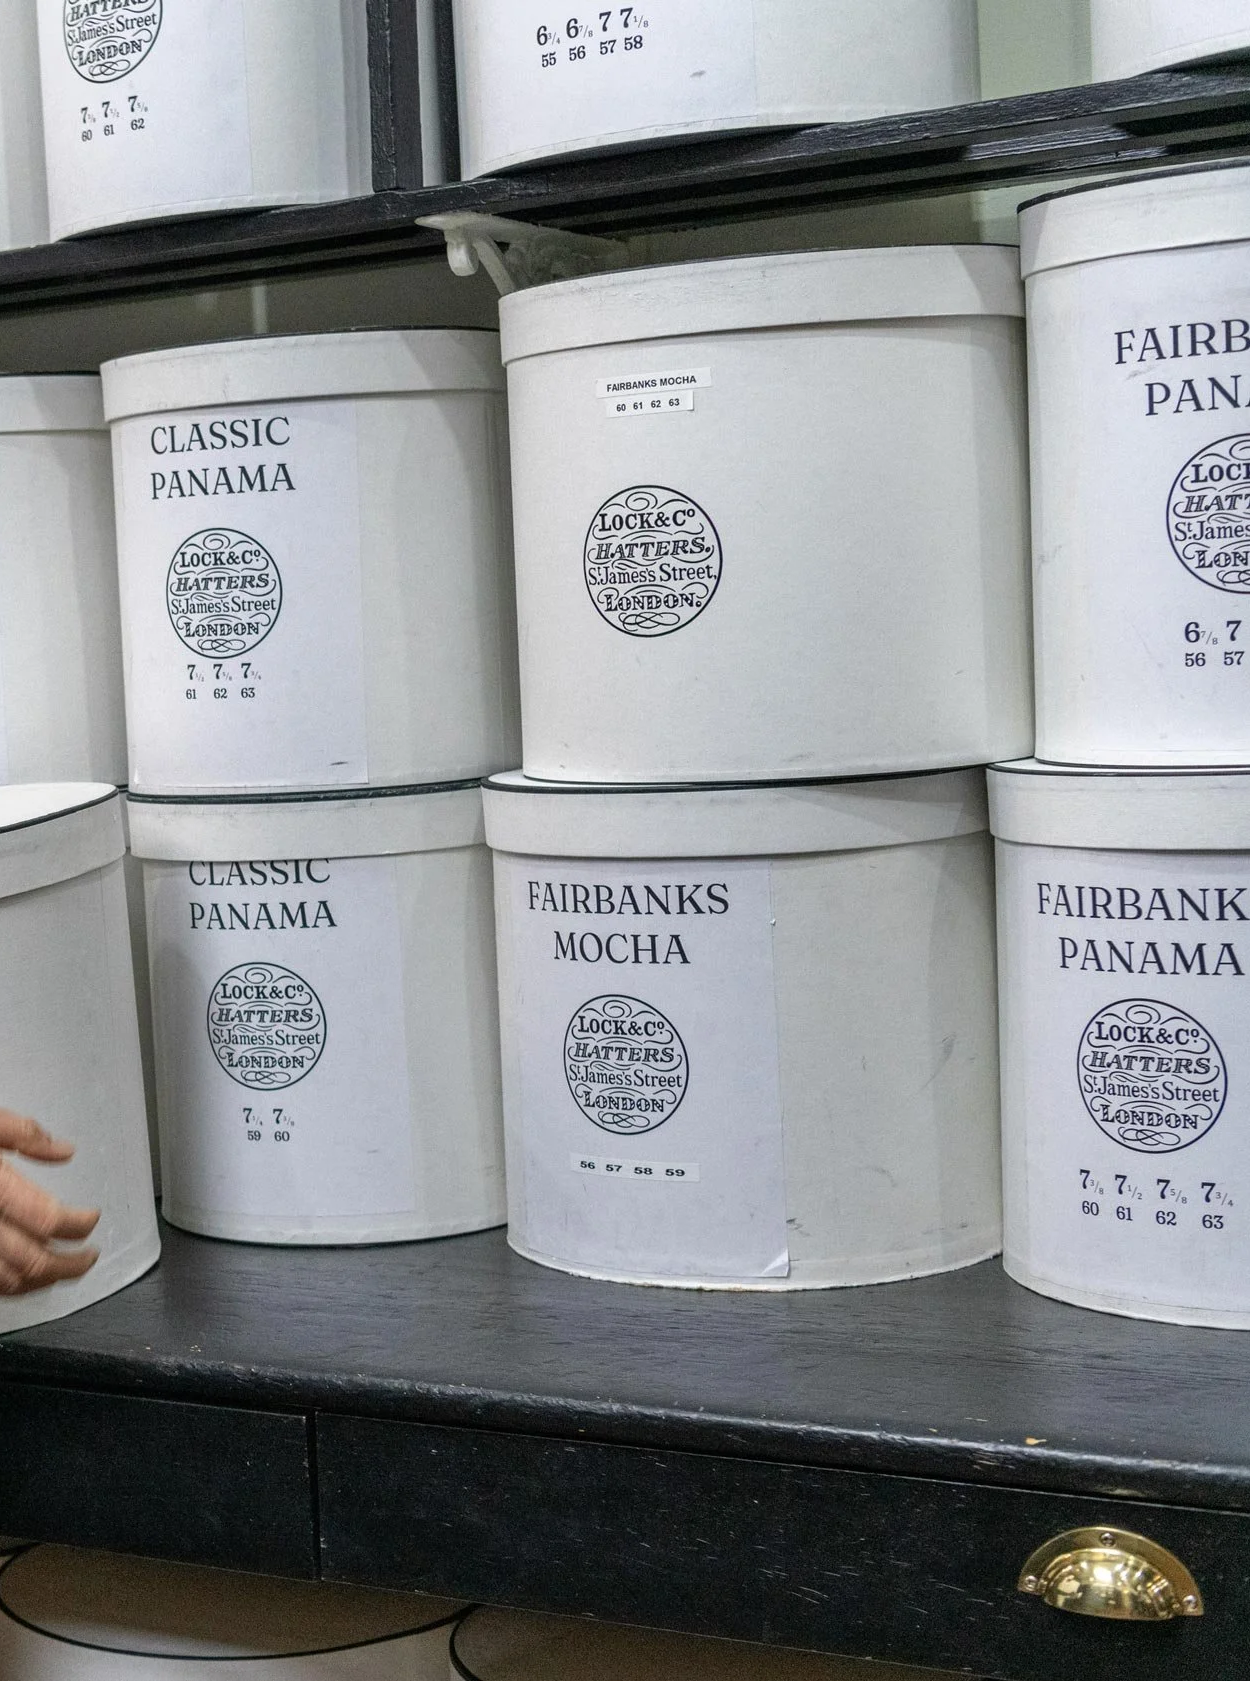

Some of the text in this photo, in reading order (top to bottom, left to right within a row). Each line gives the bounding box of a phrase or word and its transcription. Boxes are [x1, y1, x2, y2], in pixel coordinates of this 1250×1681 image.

[116, 13, 157, 32] Street
[599, 11, 613, 33] 7
[77, 39, 142, 67] LONDON
[541, 35, 644, 68] 55 56 57 58
[81, 118, 145, 142] 60 61 62
[606, 375, 697, 393] FAIRBANKS MOCHA
[1145, 374, 1250, 416] PAN
[616, 397, 680, 412] 60 61 62 63
[151, 416, 291, 455] CLASSIC
[151, 463, 296, 500] PANAMA
[175, 573, 271, 592] HATTERS
[231, 595, 276, 613] Street
[183, 621, 261, 638] LONDON
[1226, 620, 1242, 642] 7
[1184, 651, 1245, 668] 56 57
[185, 687, 256, 700] 61 62 63
[189, 858, 330, 886] CLASSIC
[528, 880, 730, 916] FAIRBANKS
[1037, 882, 1250, 921] FAIRBANK
[189, 900, 337, 930] PANAMA
[554, 931, 691, 965] MOCHA
[1058, 936, 1245, 976] PANAMA
[216, 1008, 314, 1023] HATTERS
[274, 1029, 321, 1045] Street
[227, 1052, 306, 1069] LONDON
[573, 1042, 676, 1063] HATTERS
[1089, 1051, 1212, 1075] HATTERS
[634, 1069, 683, 1088] Street
[583, 1090, 665, 1113] LONDON
[1161, 1081, 1220, 1104] Street
[1099, 1105, 1200, 1130] LONDON
[247, 1130, 290, 1142] 59 60
[579, 1160, 686, 1177] 56 57 58 59
[1082, 1200, 1225, 1230] 60 61 62 63
